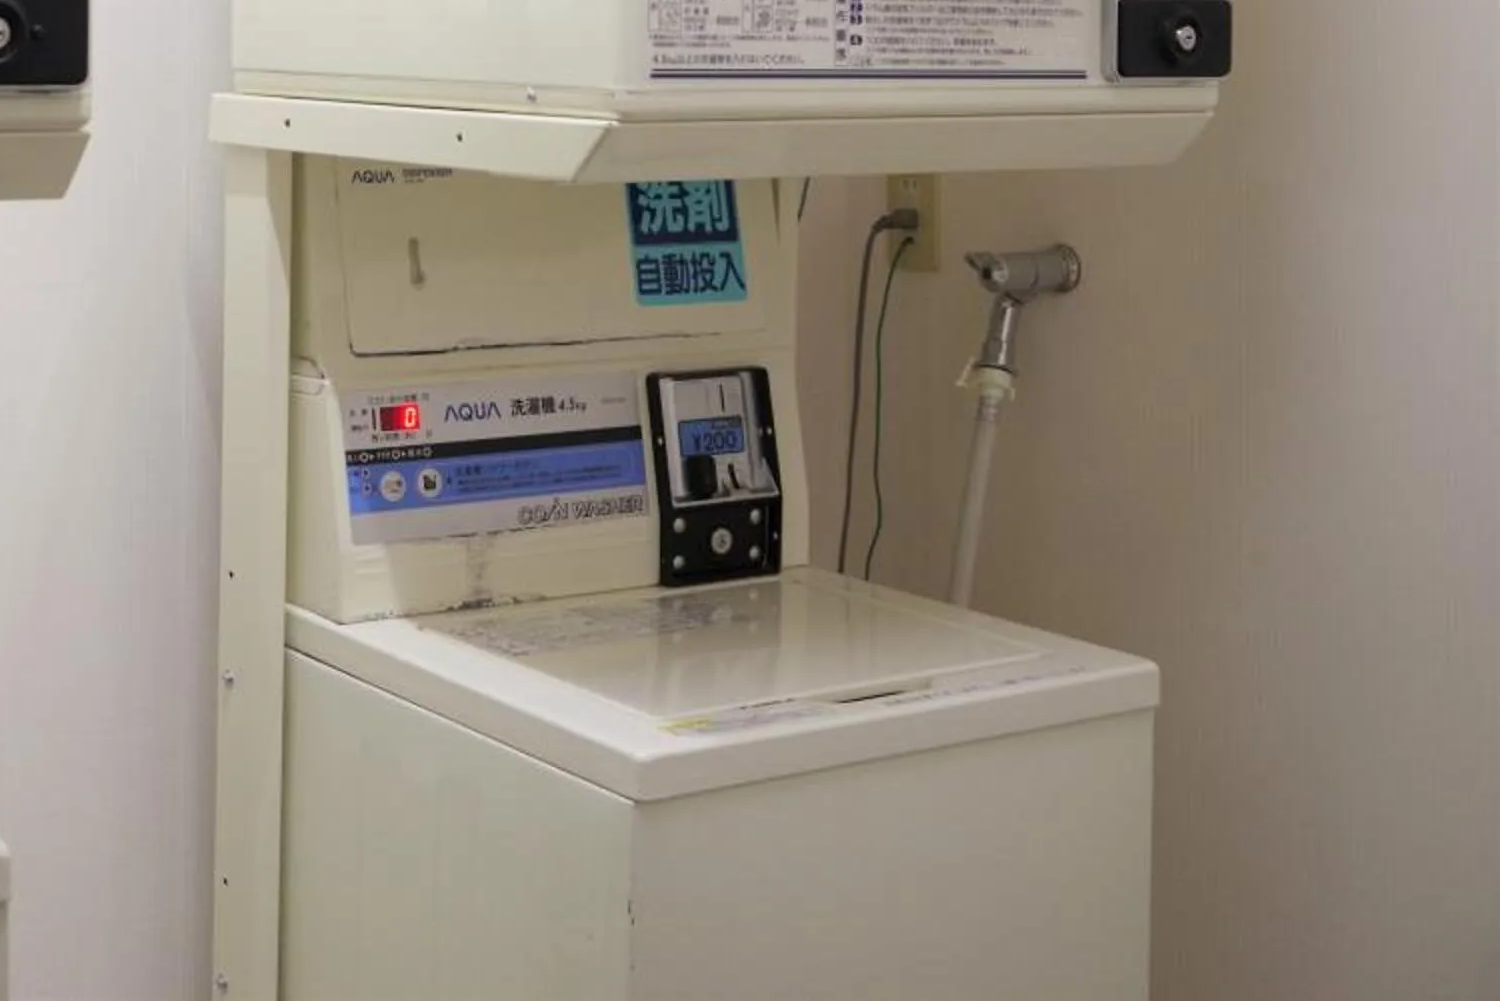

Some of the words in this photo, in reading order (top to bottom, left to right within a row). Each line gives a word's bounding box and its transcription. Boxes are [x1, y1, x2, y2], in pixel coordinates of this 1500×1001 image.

[351, 169, 396, 184] AQUA
[637, 180, 731, 235] 洗剤
[636, 251, 746, 296] 自動投入
[403, 406, 416, 428] 0
[444, 401, 501, 423] AQUA
